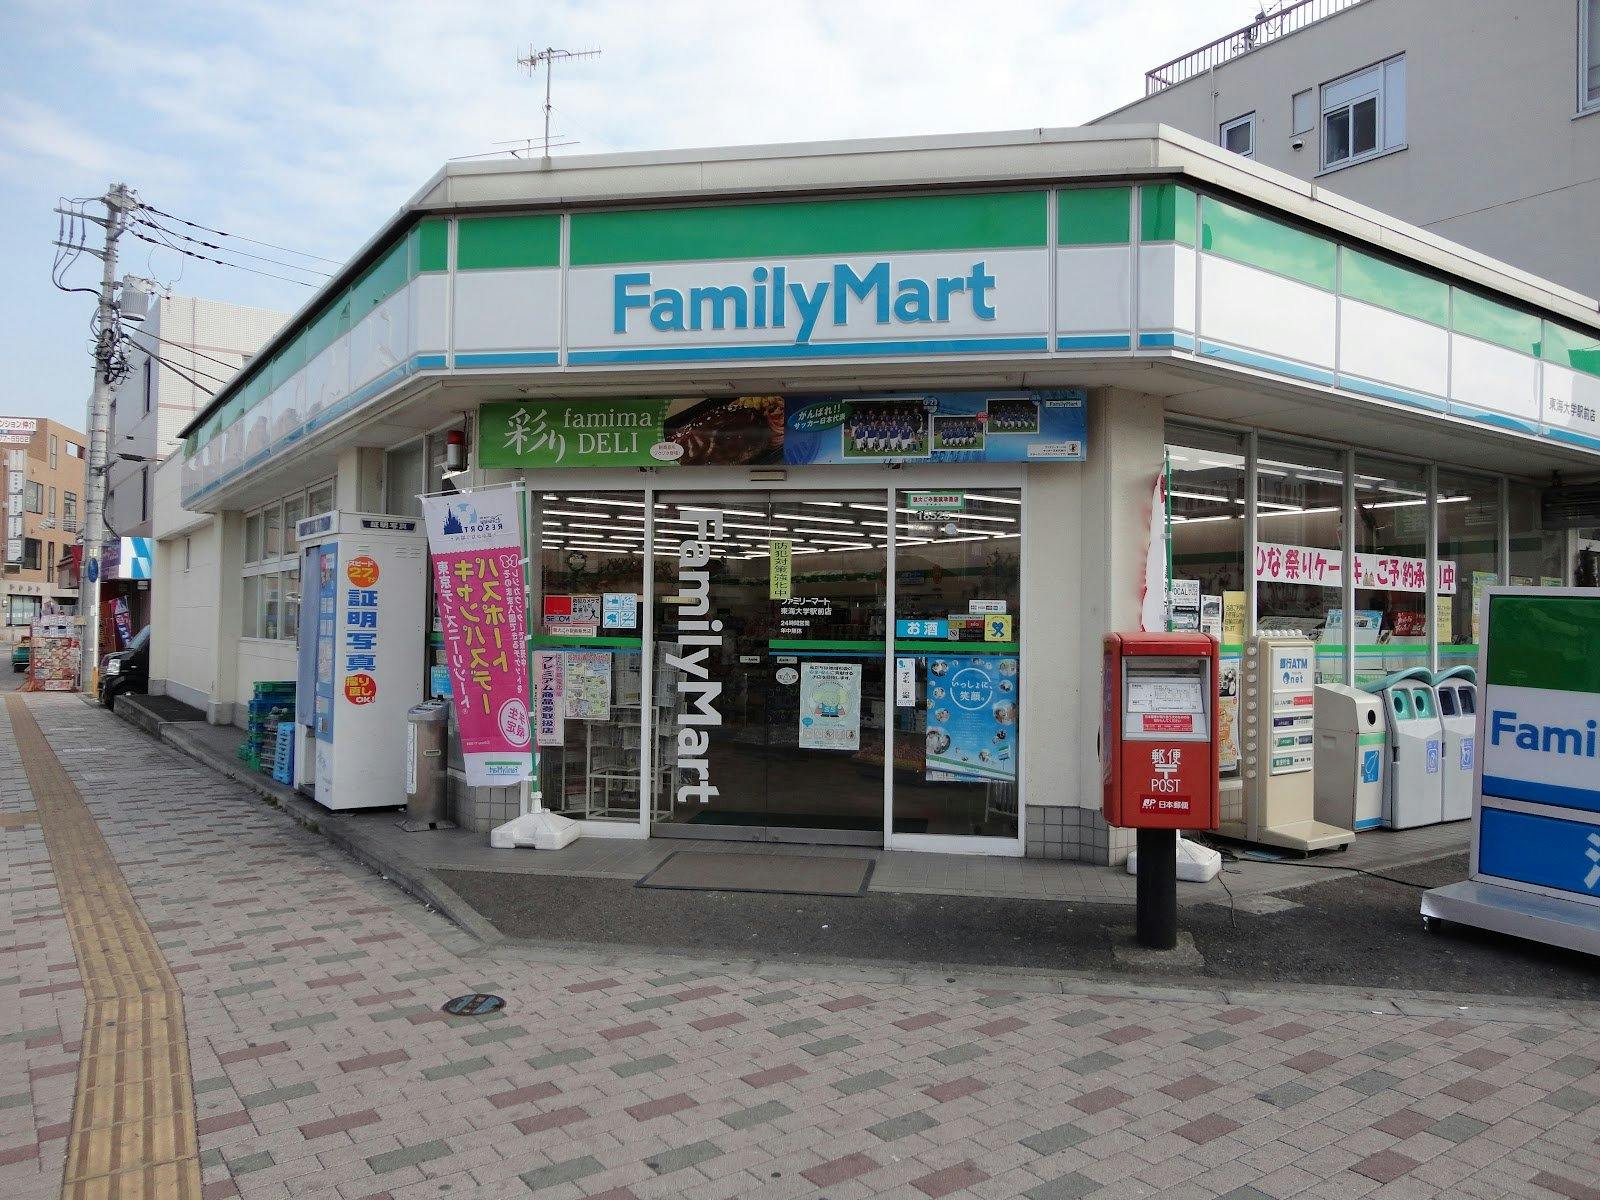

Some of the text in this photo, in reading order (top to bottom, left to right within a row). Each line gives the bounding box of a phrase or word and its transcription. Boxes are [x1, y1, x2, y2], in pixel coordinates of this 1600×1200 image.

[613, 261, 997, 346] FamilyMart
[562, 408, 653, 429] famima
[1548, 397, 1596, 422] 東海大学駅前店
[794, 412, 846, 430] サッカー日本代表
[503, 407, 566, 463] 彩り
[578, 432, 638, 455] DELI
[781, 597, 831, 605] ファミリーマート
[780, 607, 832, 616] 東海大学駅前店
[346, 589, 378, 671] 証明写真
[907, 621, 939, 636] お酒
[665, 510, 724, 803] FamilyMart
[1280, 658, 1308, 670] 銀行ATM
[1151, 748, 1181, 765] 郵便
[1151, 778, 1181, 792] POST
[1159, 800, 1189, 810] 日本郵便
